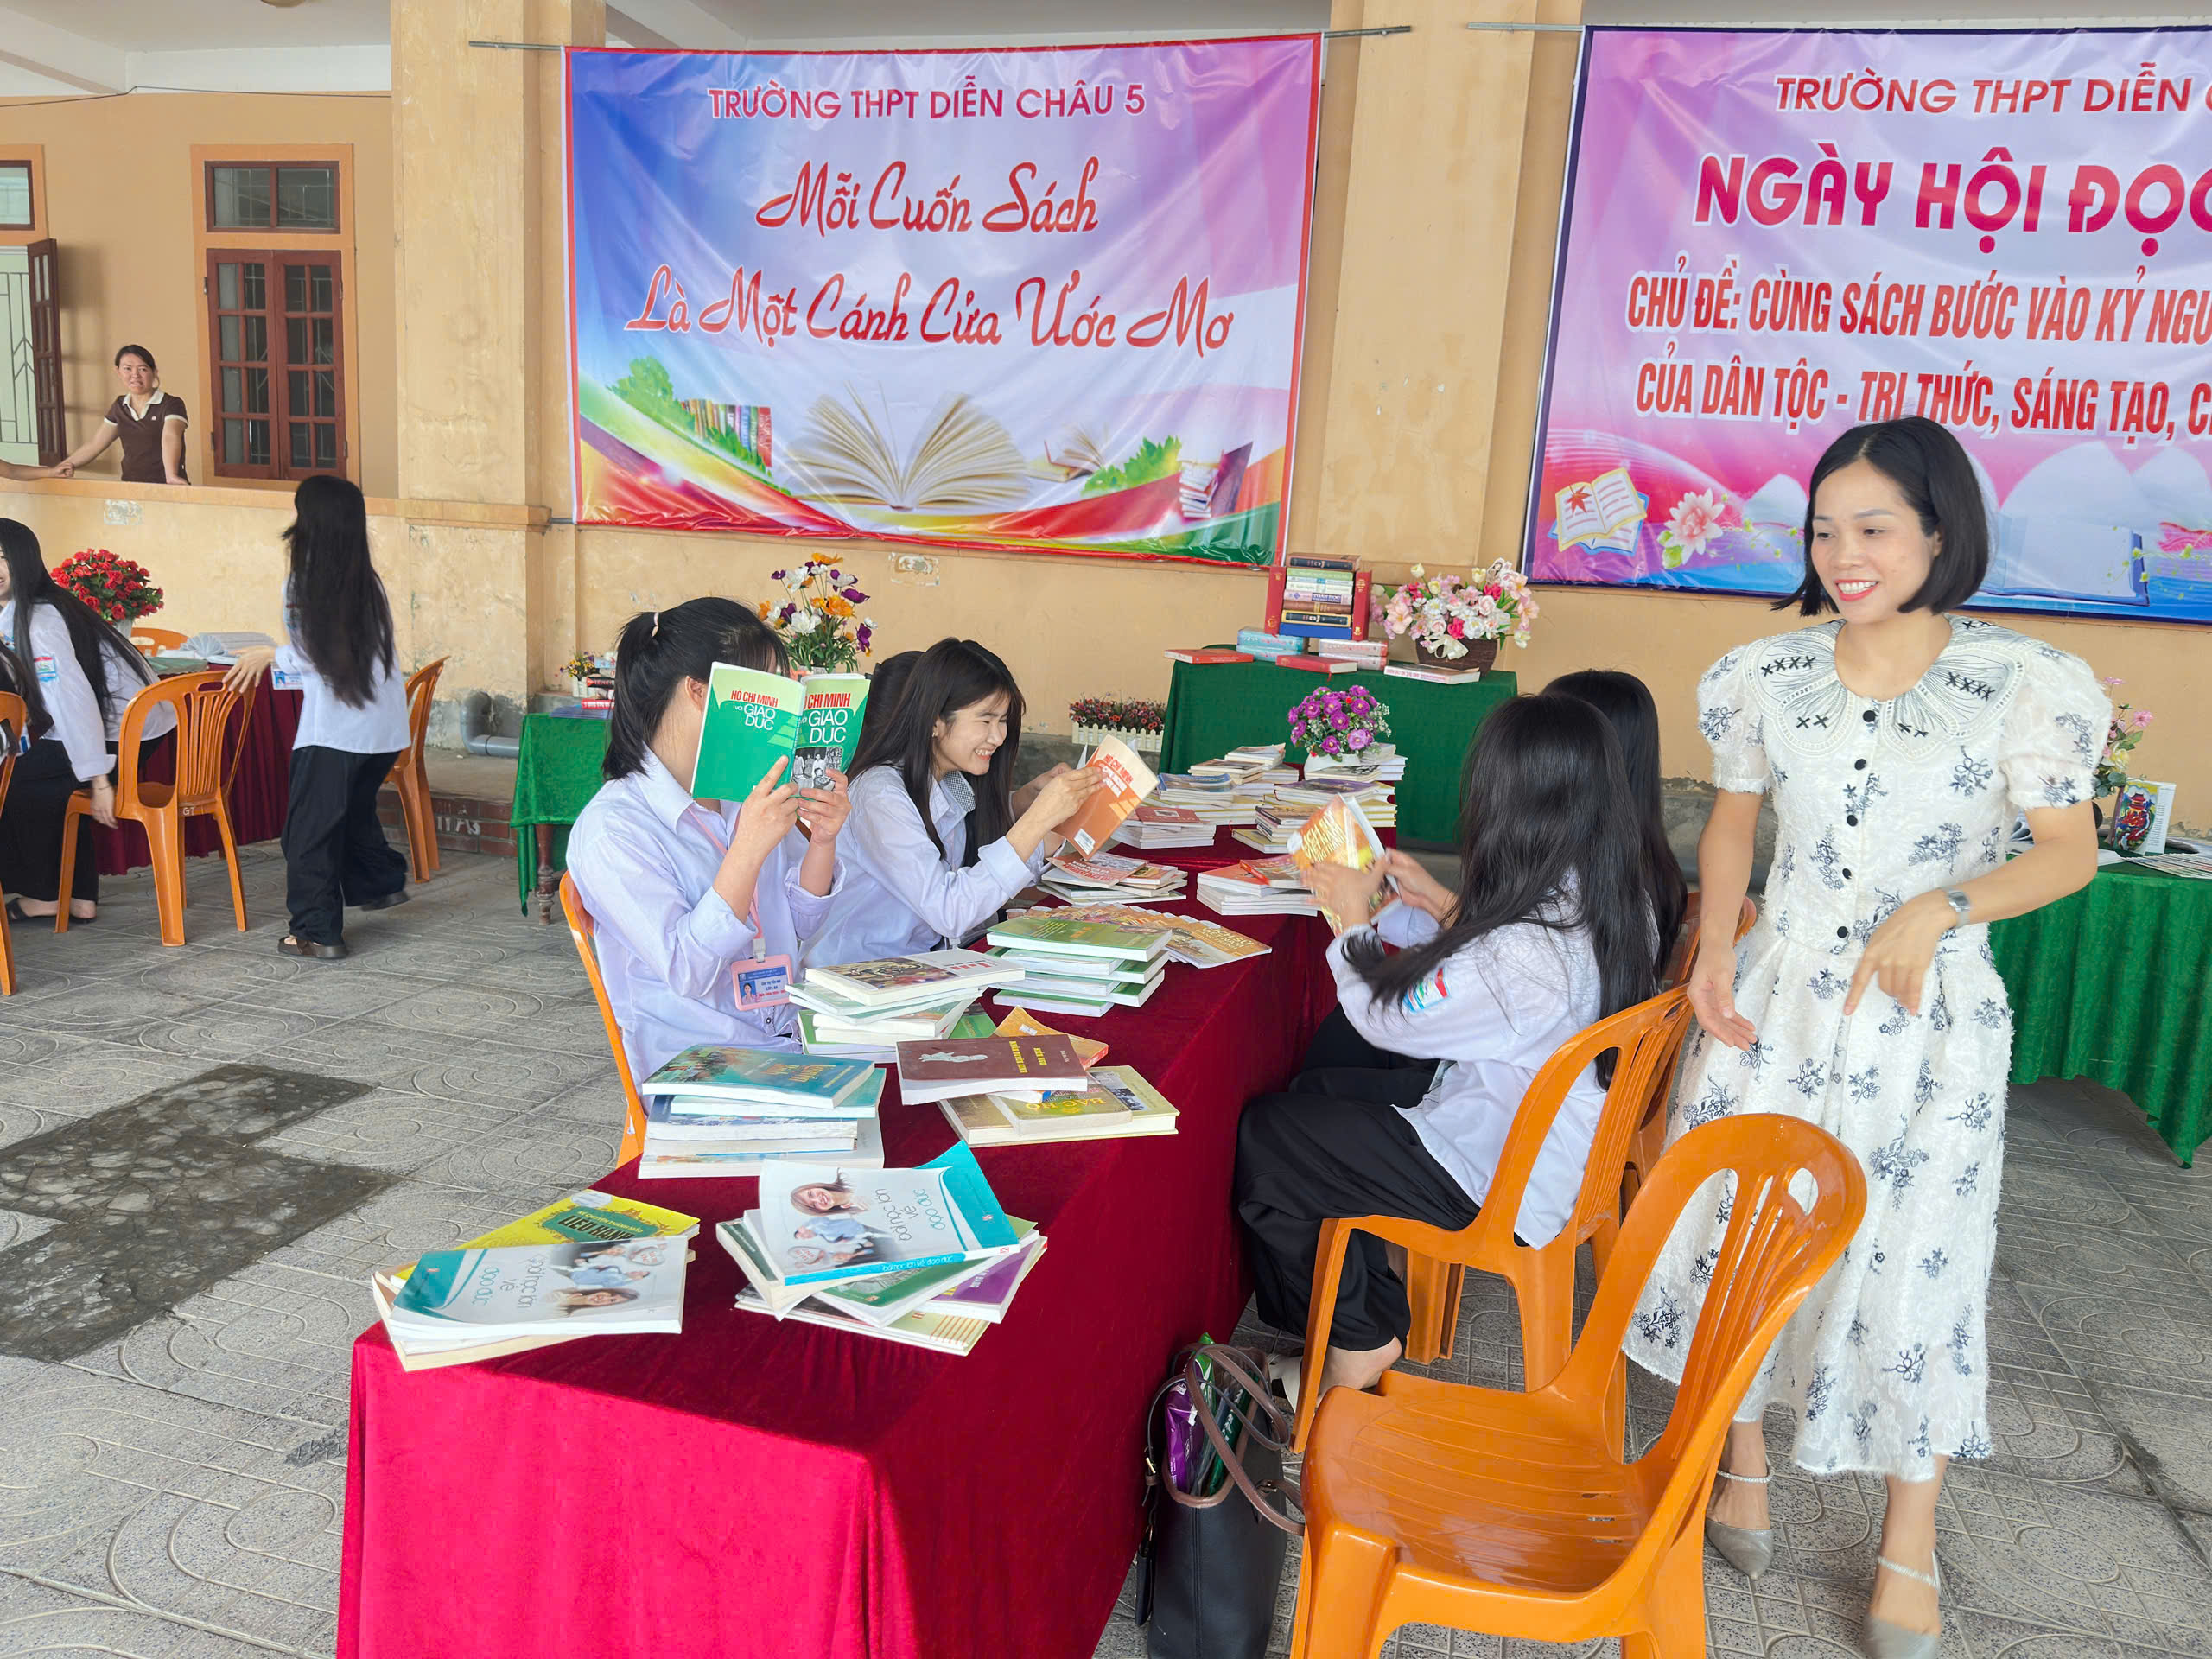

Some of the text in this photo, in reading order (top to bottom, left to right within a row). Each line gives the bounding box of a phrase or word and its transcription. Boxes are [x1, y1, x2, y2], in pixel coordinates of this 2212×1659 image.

[709, 75, 1145, 118] TRƯỜNG THPT DIỄN CHÂU 5
[1777, 61, 2192, 113] TRƯỜNG THPT DIỄN
[755, 156, 1100, 238] Mỗi Cuốn Sách
[1694, 142, 1893, 226] NGÀY
[1914, 145, 2047, 254] HỘI
[623, 264, 1234, 358] Là Một Cánh Cửa Ước Mơ
[1628, 254, 1688, 327] CHỦ
[1693, 258, 1741, 330] ĐỀ:
[1749, 269, 1833, 334] CÙNG
[1840, 272, 1925, 336] SÁCH
[1929, 268, 2018, 340] BƯỚC
[2027, 275, 2090, 341] VÀO
[2095, 264, 2145, 342] KỶ
[1637, 340, 1693, 413] CỦA
[1701, 355, 1765, 416] DÂN
[1774, 358, 1829, 430] TỘC
[1859, 371, 1908, 423] TRI
[1916, 359, 1999, 434] THỨC,
[2011, 367, 2099, 432] SÁNG
[2109, 380, 2175, 445] TẠO,
[757, 693, 779, 708] MINH
[823, 692, 851, 708] MINH
